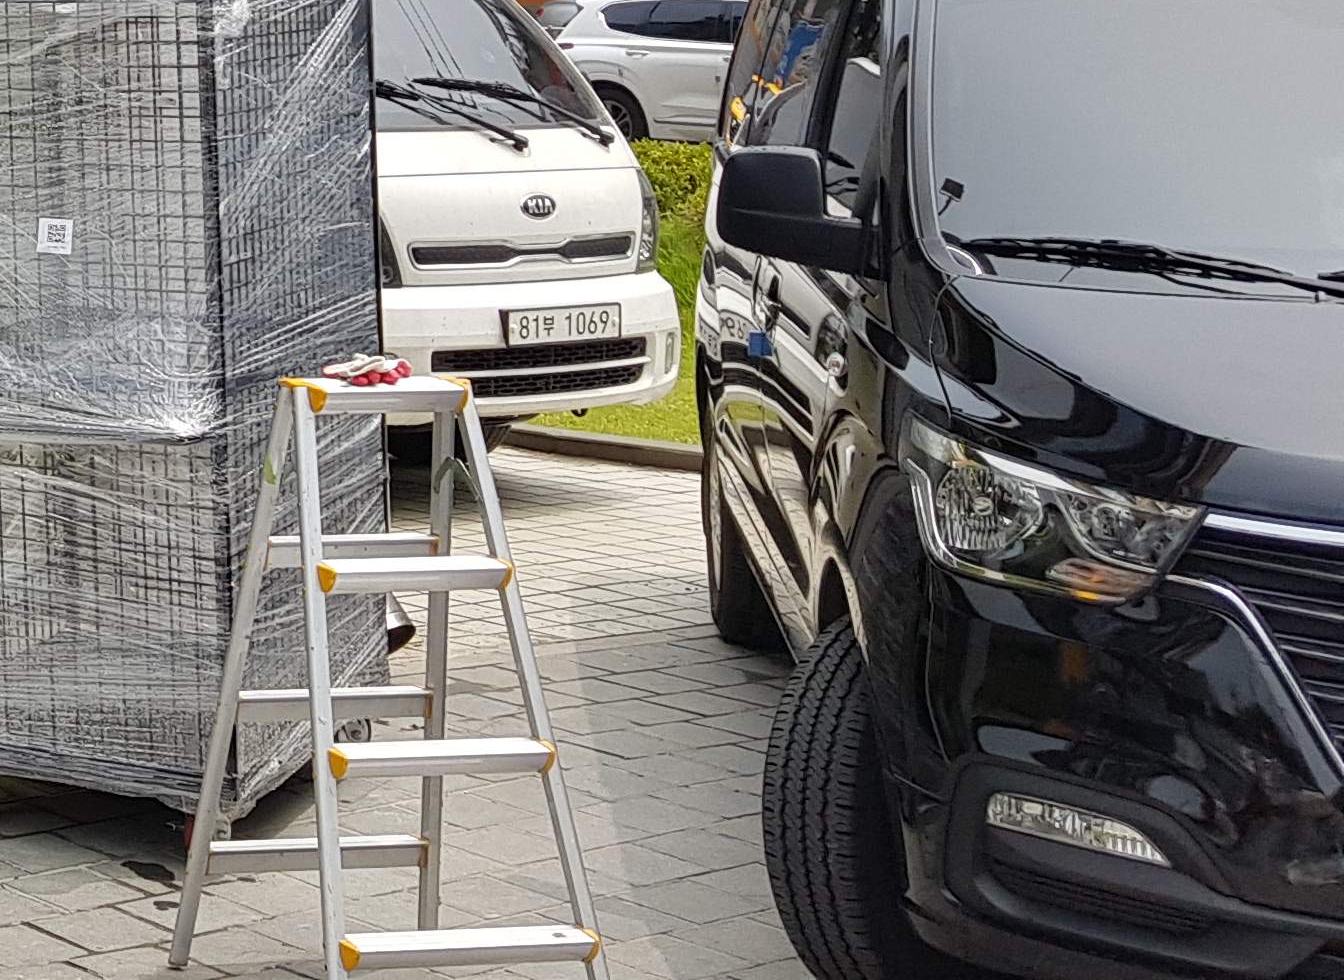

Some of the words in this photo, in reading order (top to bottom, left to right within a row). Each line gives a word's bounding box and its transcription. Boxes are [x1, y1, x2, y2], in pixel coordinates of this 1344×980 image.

[527, 198, 553, 214] KIA
[519, 314, 555, 340] 81부
[565, 310, 610, 337] 1069
